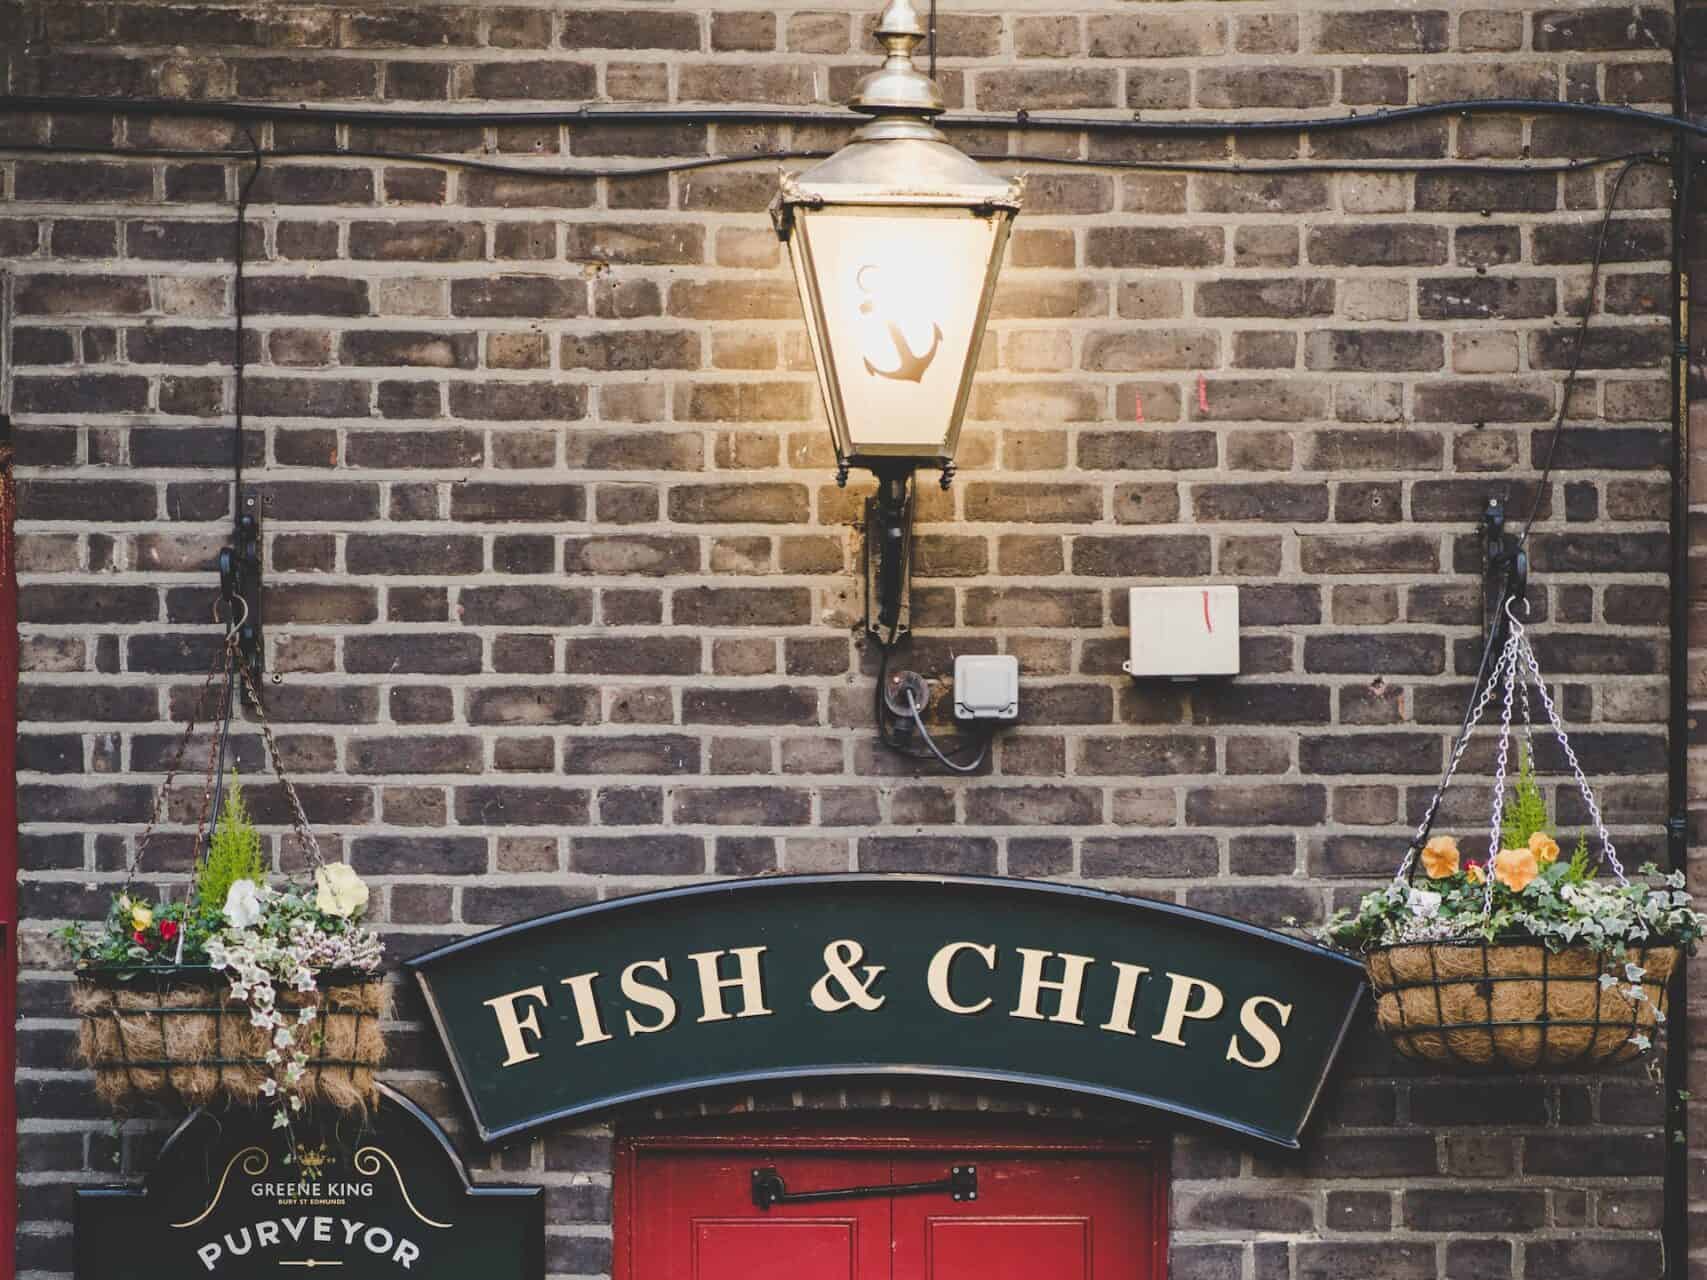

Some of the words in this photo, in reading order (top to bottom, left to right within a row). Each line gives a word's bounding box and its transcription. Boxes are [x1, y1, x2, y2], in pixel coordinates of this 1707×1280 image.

[482, 945, 774, 1068] FISH
[810, 938, 886, 1012] &
[926, 940, 1295, 1069] CHIPS
[250, 1182, 321, 1197] GREENE
[327, 1182, 374, 1197] KING
[197, 1215, 421, 1271] PURVEYOR
